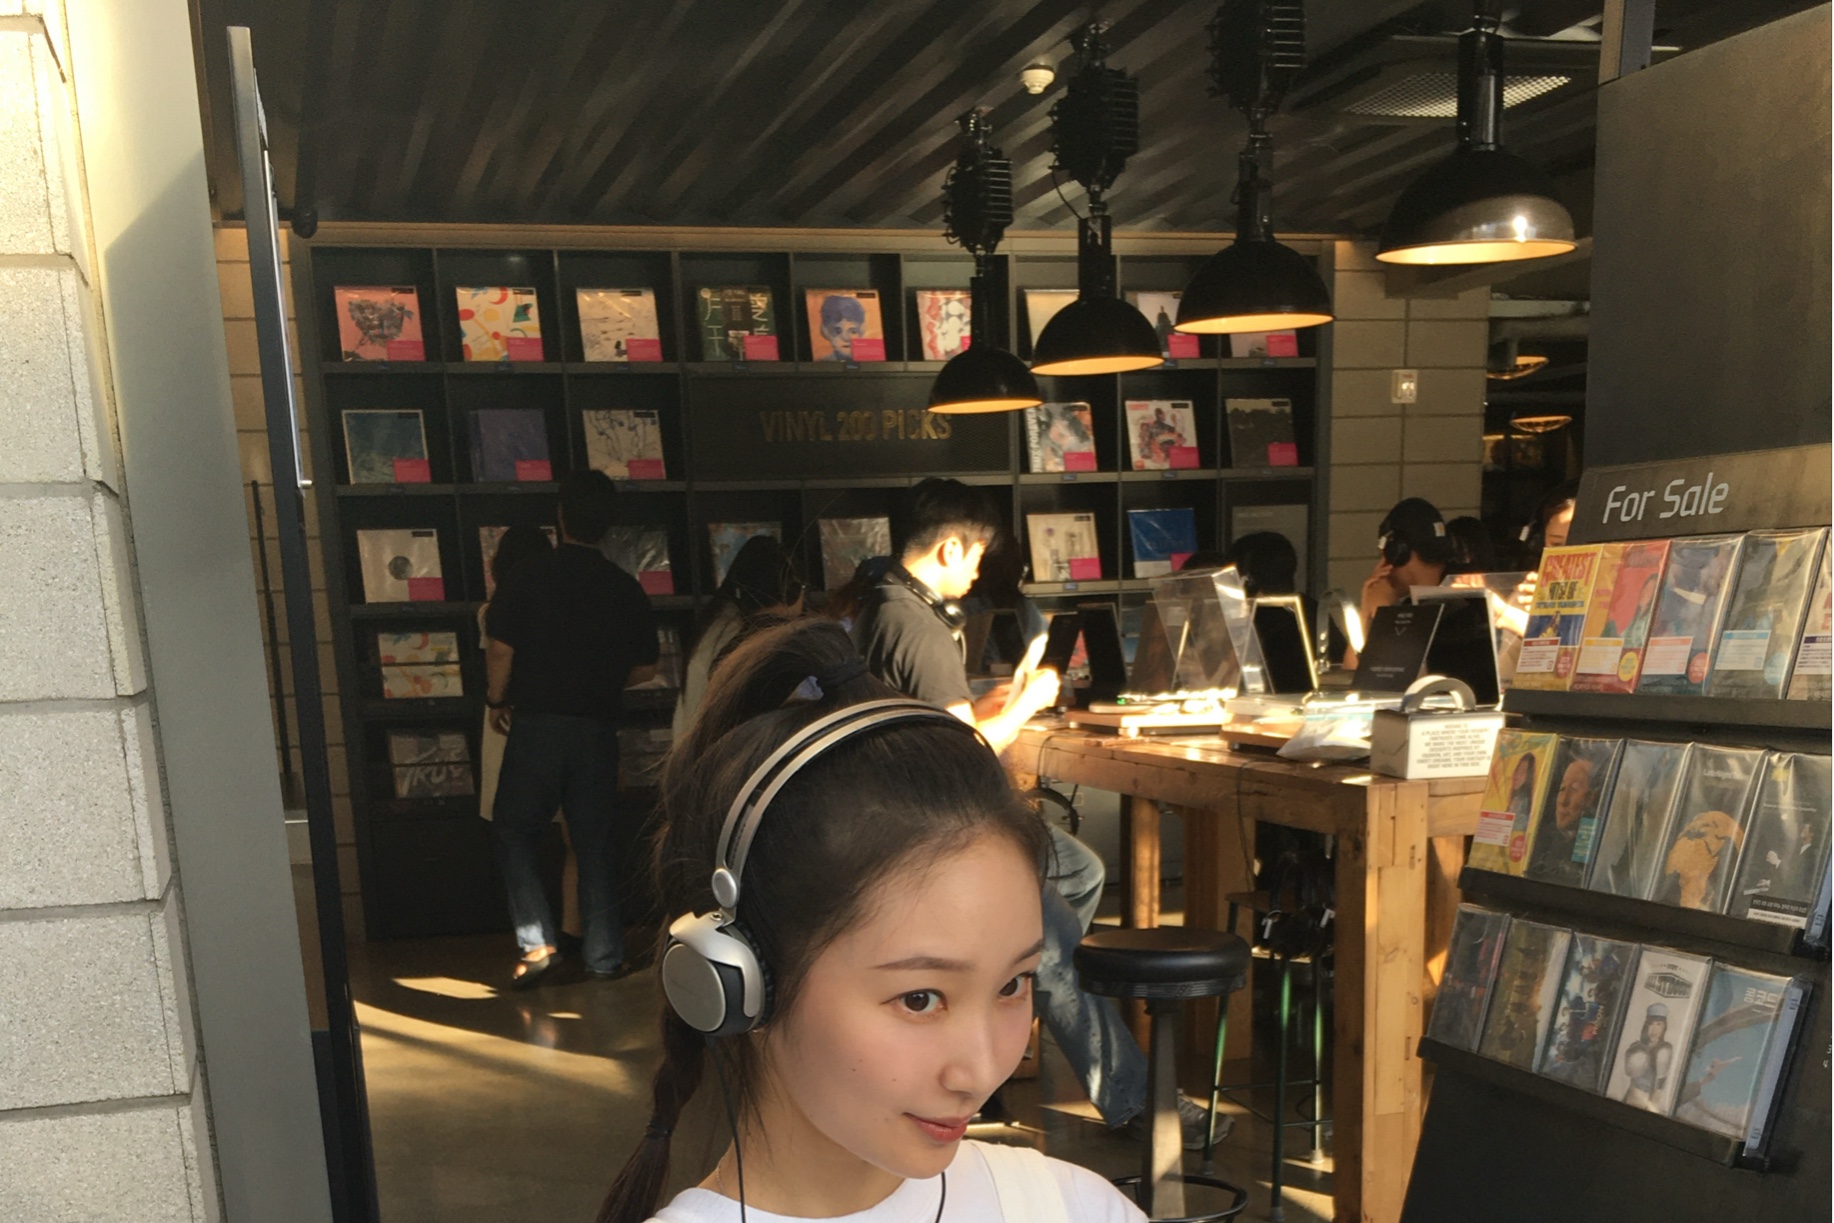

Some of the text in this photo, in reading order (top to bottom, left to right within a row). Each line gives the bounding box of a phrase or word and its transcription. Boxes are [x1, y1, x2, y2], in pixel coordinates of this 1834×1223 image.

[759, 410, 834, 442] VINYL
[882, 408, 953, 440] PICKS
[1602, 472, 1729, 524] For Sale
[1540, 552, 1597, 588] GREATEST
